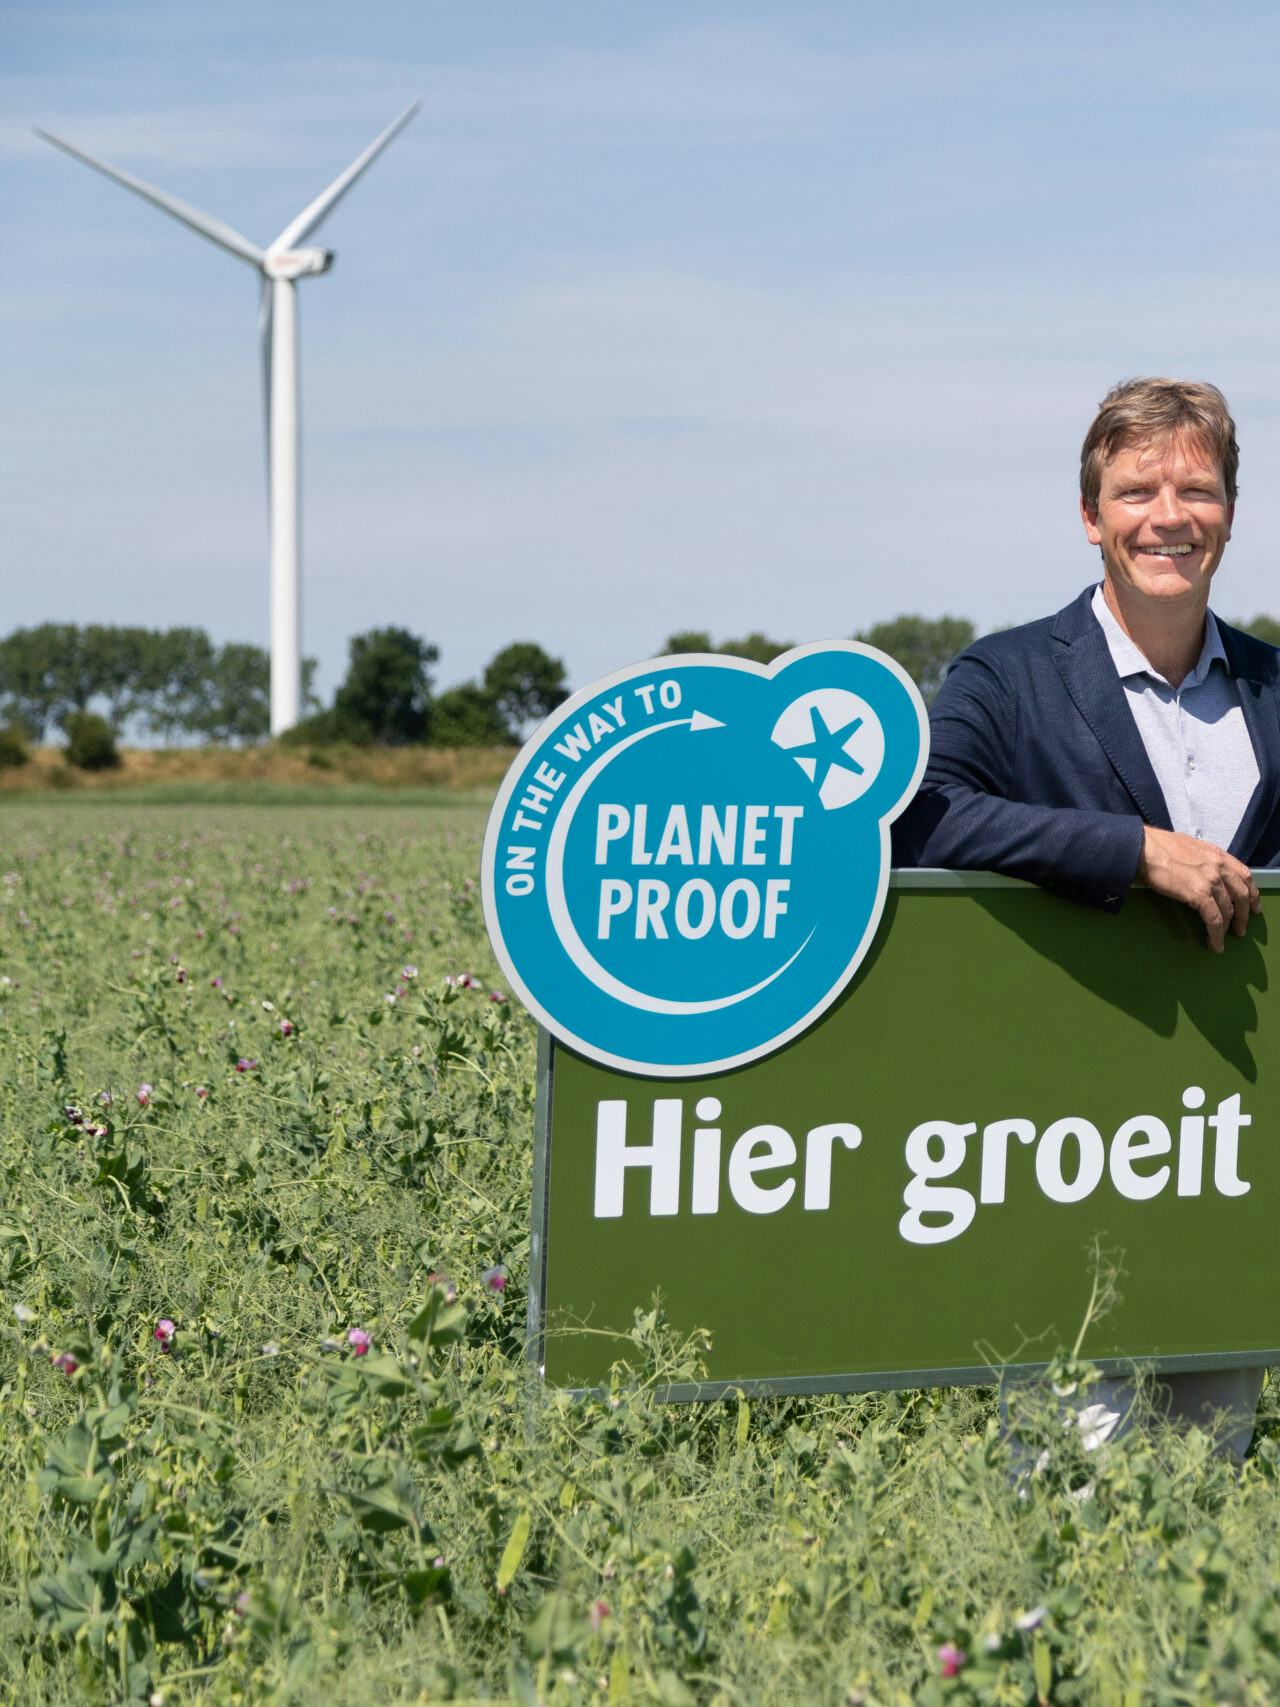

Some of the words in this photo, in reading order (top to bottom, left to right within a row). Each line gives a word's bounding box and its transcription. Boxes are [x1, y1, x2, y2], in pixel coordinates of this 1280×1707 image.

[634, 680, 682, 715] TO
[553, 696, 627, 764] WAY
[512, 761, 567, 834] THE
[595, 803, 804, 866] PLANET
[506, 845, 536, 897] ON
[597, 878, 791, 940] PROOF
[594, 1097, 863, 1218] Hier
[898, 1086, 1252, 1245] groeit
